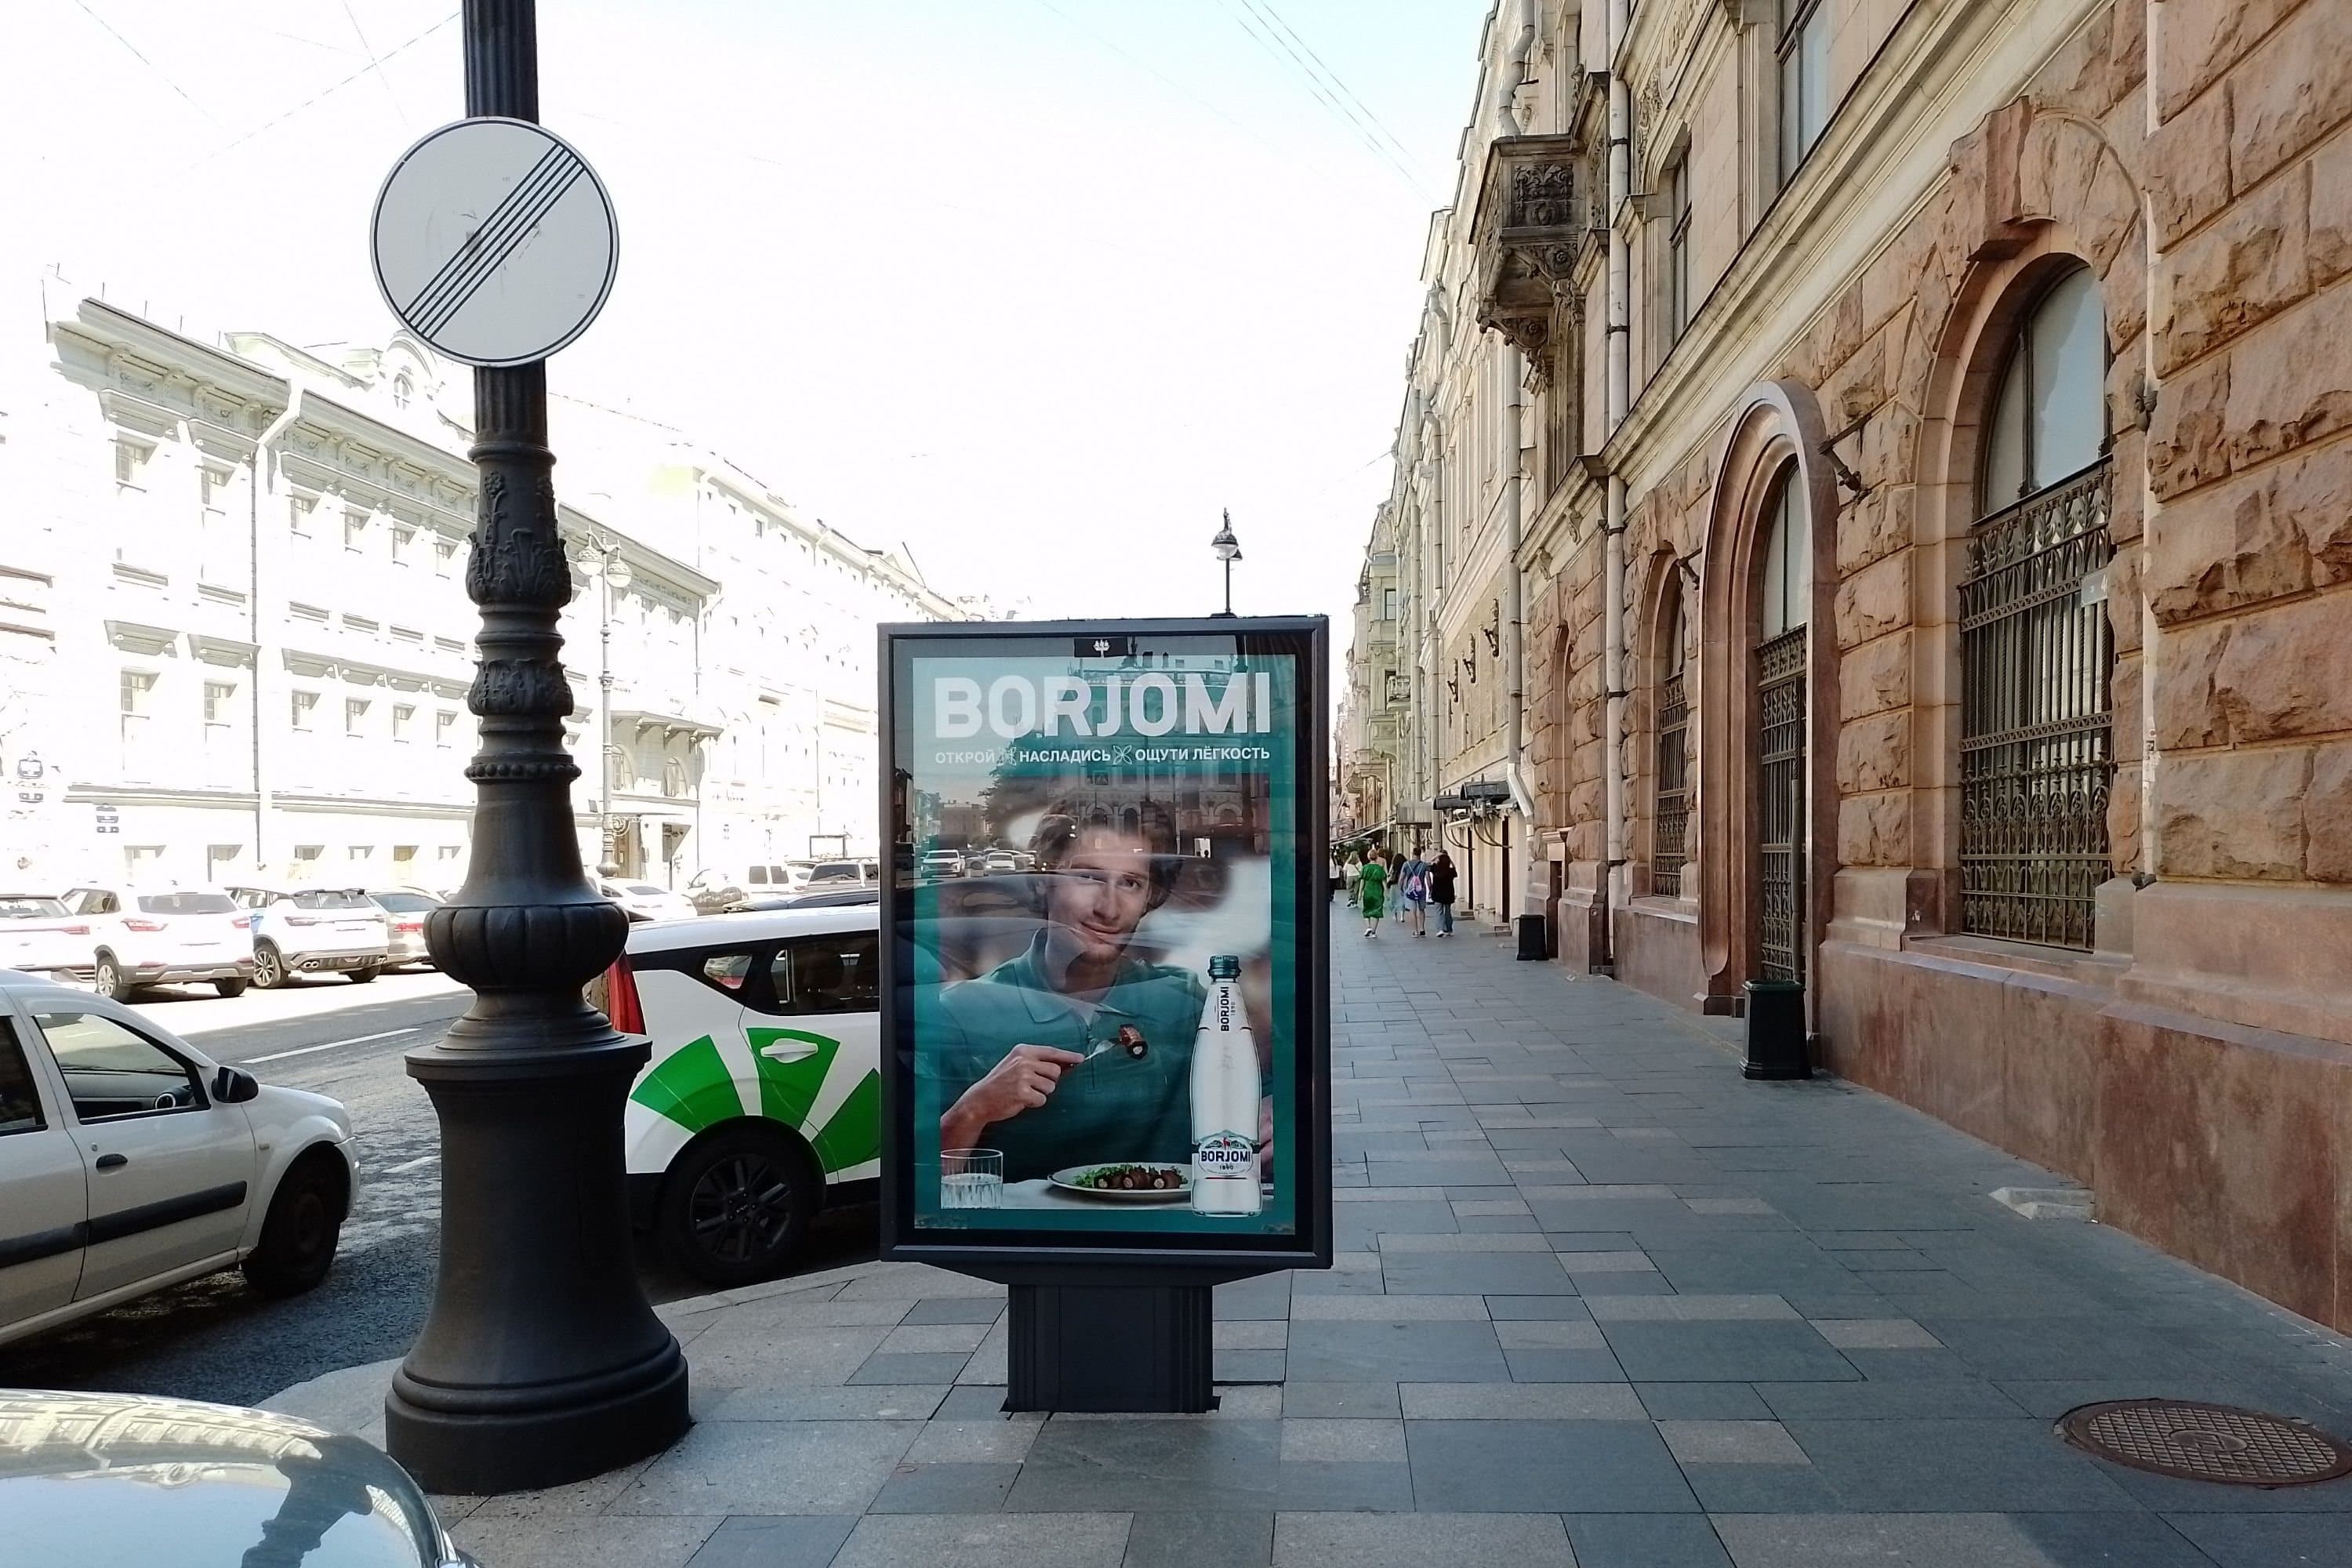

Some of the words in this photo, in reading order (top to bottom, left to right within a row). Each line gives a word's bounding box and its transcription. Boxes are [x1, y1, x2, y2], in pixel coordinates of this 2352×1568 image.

[935, 672, 1272, 737] BORJOMI
[935, 749, 995, 764] ОТКРОЙ
[1019, 749, 1111, 765] НАСЛАДИСЬ
[1135, 748, 1189, 763] ОЩУТИ
[1192, 746, 1270, 760] ЛЁГКОСТЬ
[1221, 986, 1229, 1031] BORJOMI
[1200, 1150, 1250, 1162] BORJOMI
